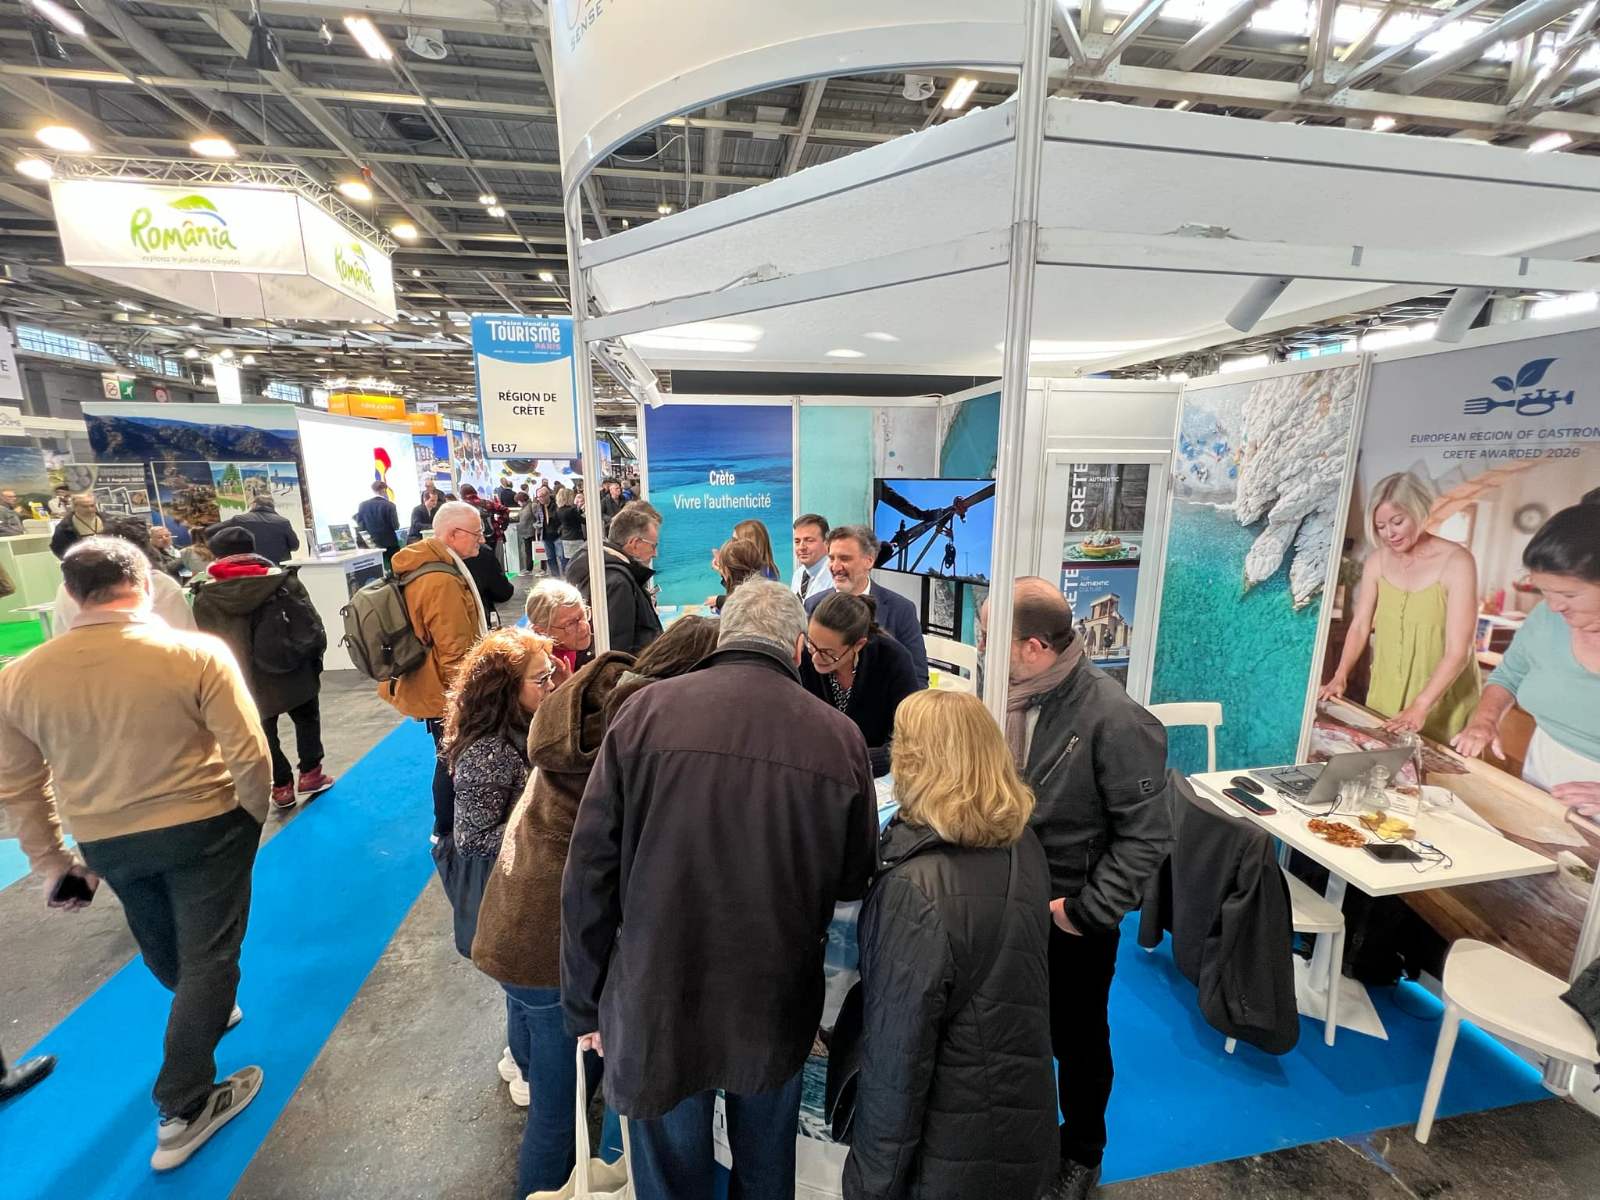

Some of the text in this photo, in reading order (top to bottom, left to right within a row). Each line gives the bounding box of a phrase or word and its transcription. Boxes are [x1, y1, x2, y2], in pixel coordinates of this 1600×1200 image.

[130, 206, 238, 254] România
[498, 389, 557, 402] RÉGION DE
[1410, 431, 1466, 443] EUROPEAN
[1470, 430, 1513, 441] REGION
[1516, 429, 1534, 440] OF
[491, 443, 518, 453] E037
[1442, 448, 1581, 460] CRETE AWARDED 2026
[710, 470, 735, 486] Crète
[674, 493, 772, 510] Vivre l'authenticité
[1070, 464, 1088, 528] CRETE
